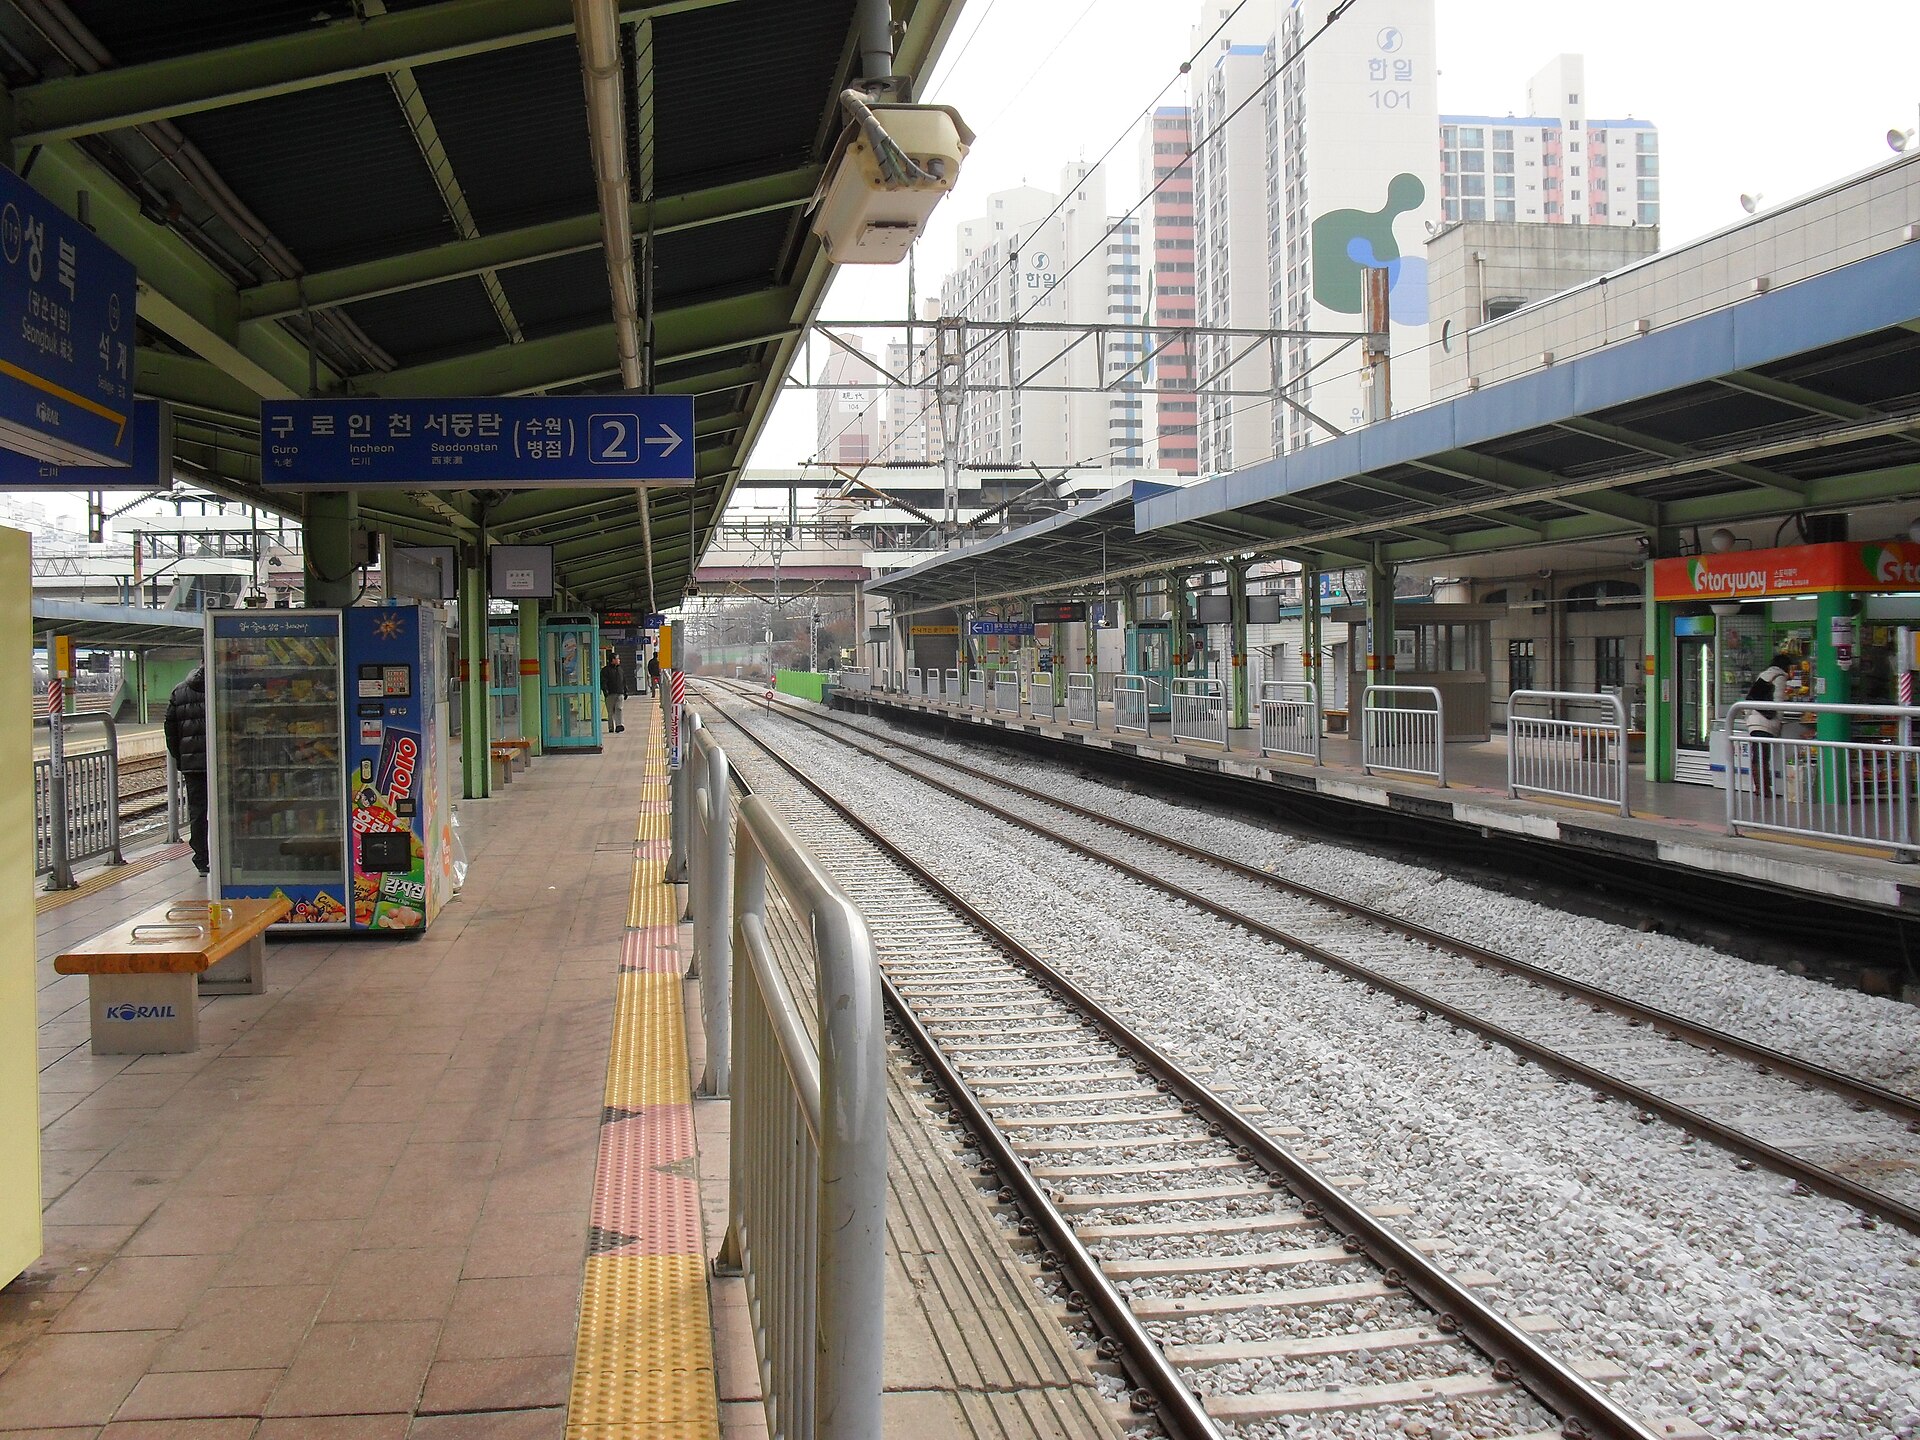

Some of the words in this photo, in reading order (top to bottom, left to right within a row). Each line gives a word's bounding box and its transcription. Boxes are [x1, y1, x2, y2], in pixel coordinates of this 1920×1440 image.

[1368, 57, 1412, 81] 한일
[1368, 89, 1411, 109] 101
[1026, 272, 1056, 289] 한일
[1031, 295, 1052, 307] 201
[424, 413, 503, 438] 서동탄
[602, 420, 627, 458] 2
[271, 444, 298, 454] Guro
[350, 443, 395, 453] Incheon
[431, 442, 498, 452] Seodongtan
[274, 458, 293, 468] 九老
[351, 456, 371, 466] 仁川
[39, 467, 58, 477] 仁川
[1694, 568, 1767, 597] Storyway
[107, 1004, 175, 1020] KORAIL
